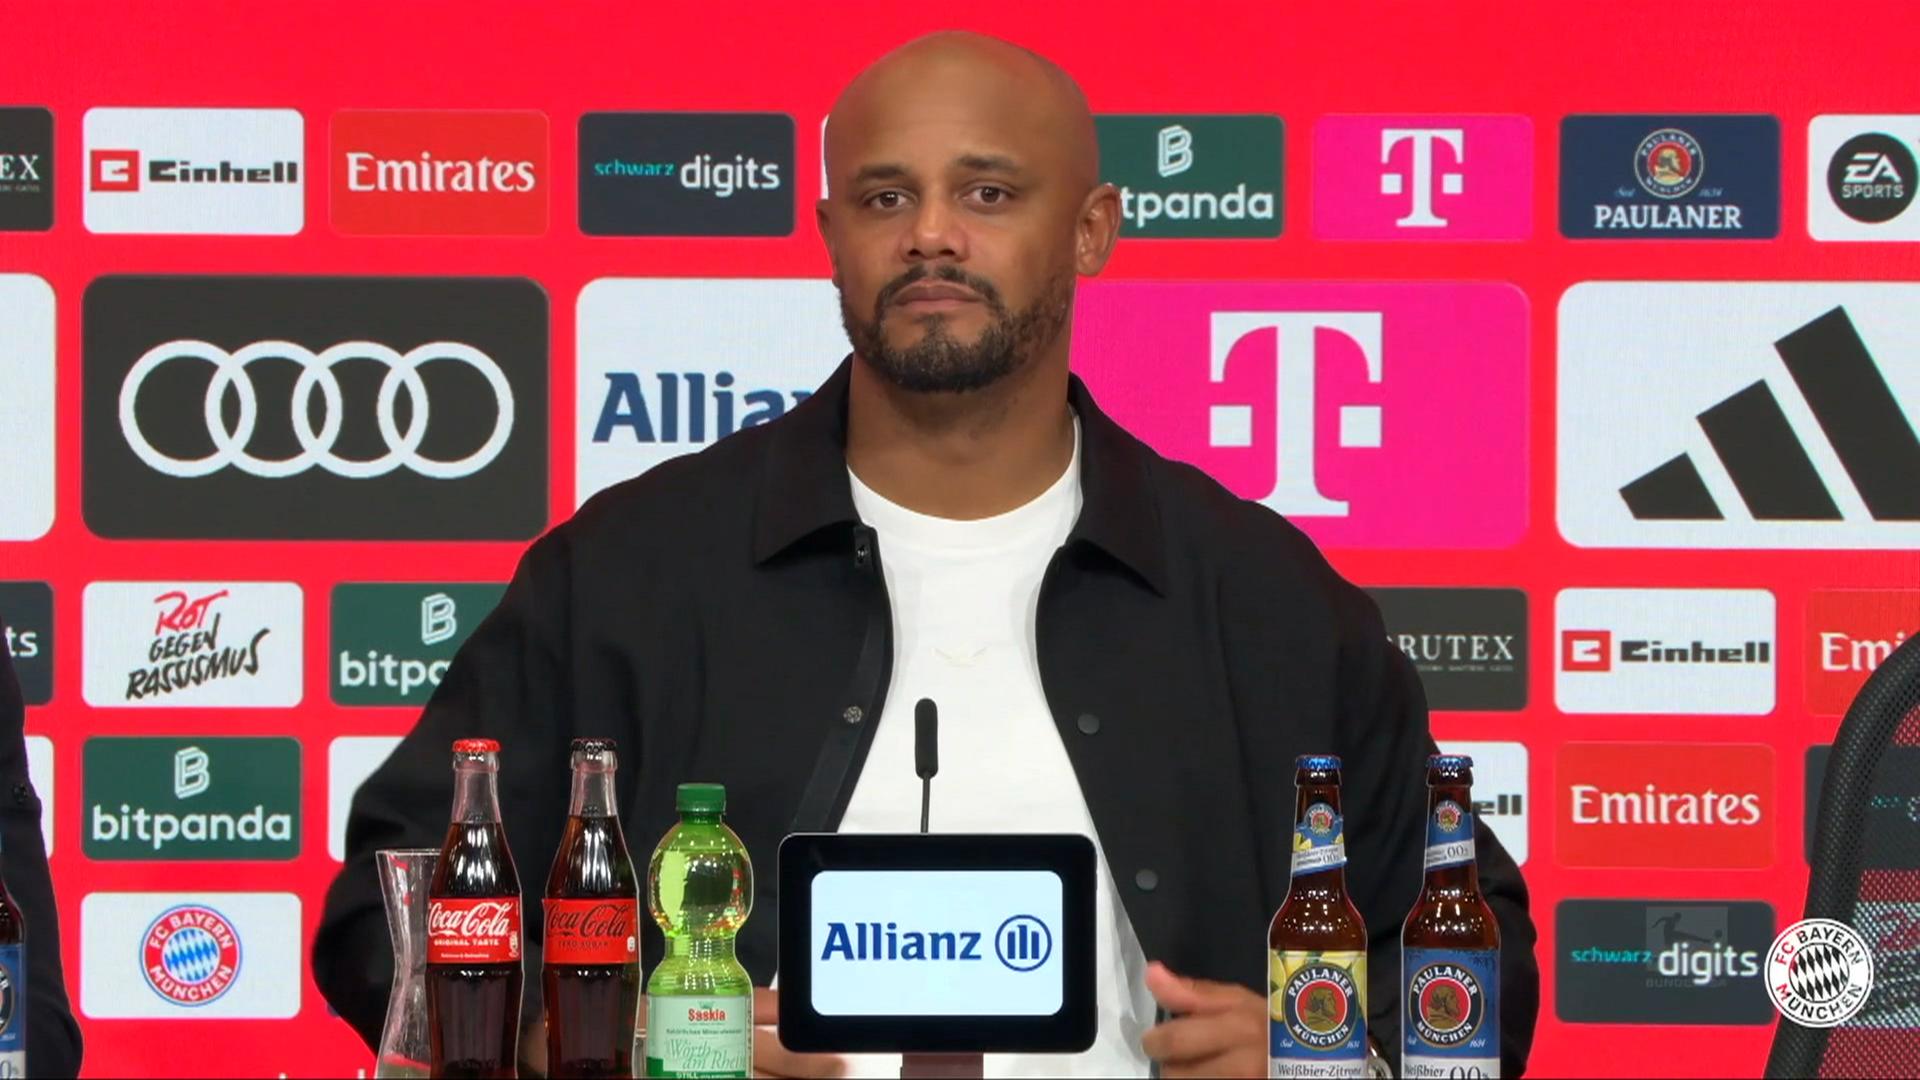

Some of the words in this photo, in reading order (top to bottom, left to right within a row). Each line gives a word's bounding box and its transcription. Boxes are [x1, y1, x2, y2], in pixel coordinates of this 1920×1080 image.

[149, 160, 298, 183] Einhell
[346, 151, 536, 193] Emirates
[594, 160, 674, 177] schwarz
[680, 155, 780, 197] digits
[1381, 128, 1464, 227] T
[1843, 152, 1902, 183] EA
[1121, 182, 1273, 228] tpanda
[1842, 184, 1904, 199] SPORTS
[1594, 205, 1743, 229] PAULANER
[592, 371, 816, 443] Allia
[1210, 312, 1382, 516] T
[149, 612, 220, 663] GEGEN
[1387, 634, 1514, 661] RUTEX
[1620, 641, 1770, 664] Einhell
[125, 628, 270, 701] RASSISMUS
[1570, 783, 1761, 825] Emirates
[92, 804, 292, 850] bitpanda
[149, 925, 169, 949] FC
[169, 912, 233, 948] BAYERN
[428, 902, 514, 937] Coca-Cola
[546, 903, 630, 938] Coca-Cola
[821, 922, 982, 960] Allianz
[1413, 966, 1478, 995] PAULANER
[1571, 947, 1653, 964] schwarz
[1658, 943, 1760, 985] digits
[149, 965, 232, 1001] MÜNCHEN
[1288, 968, 1354, 997] PAULANER
[688, 1007, 726, 1022] Saskia
[1416, 1021, 1473, 1043] MÜNCHEN
[1293, 1023, 1349, 1045] MÜNCHEN
